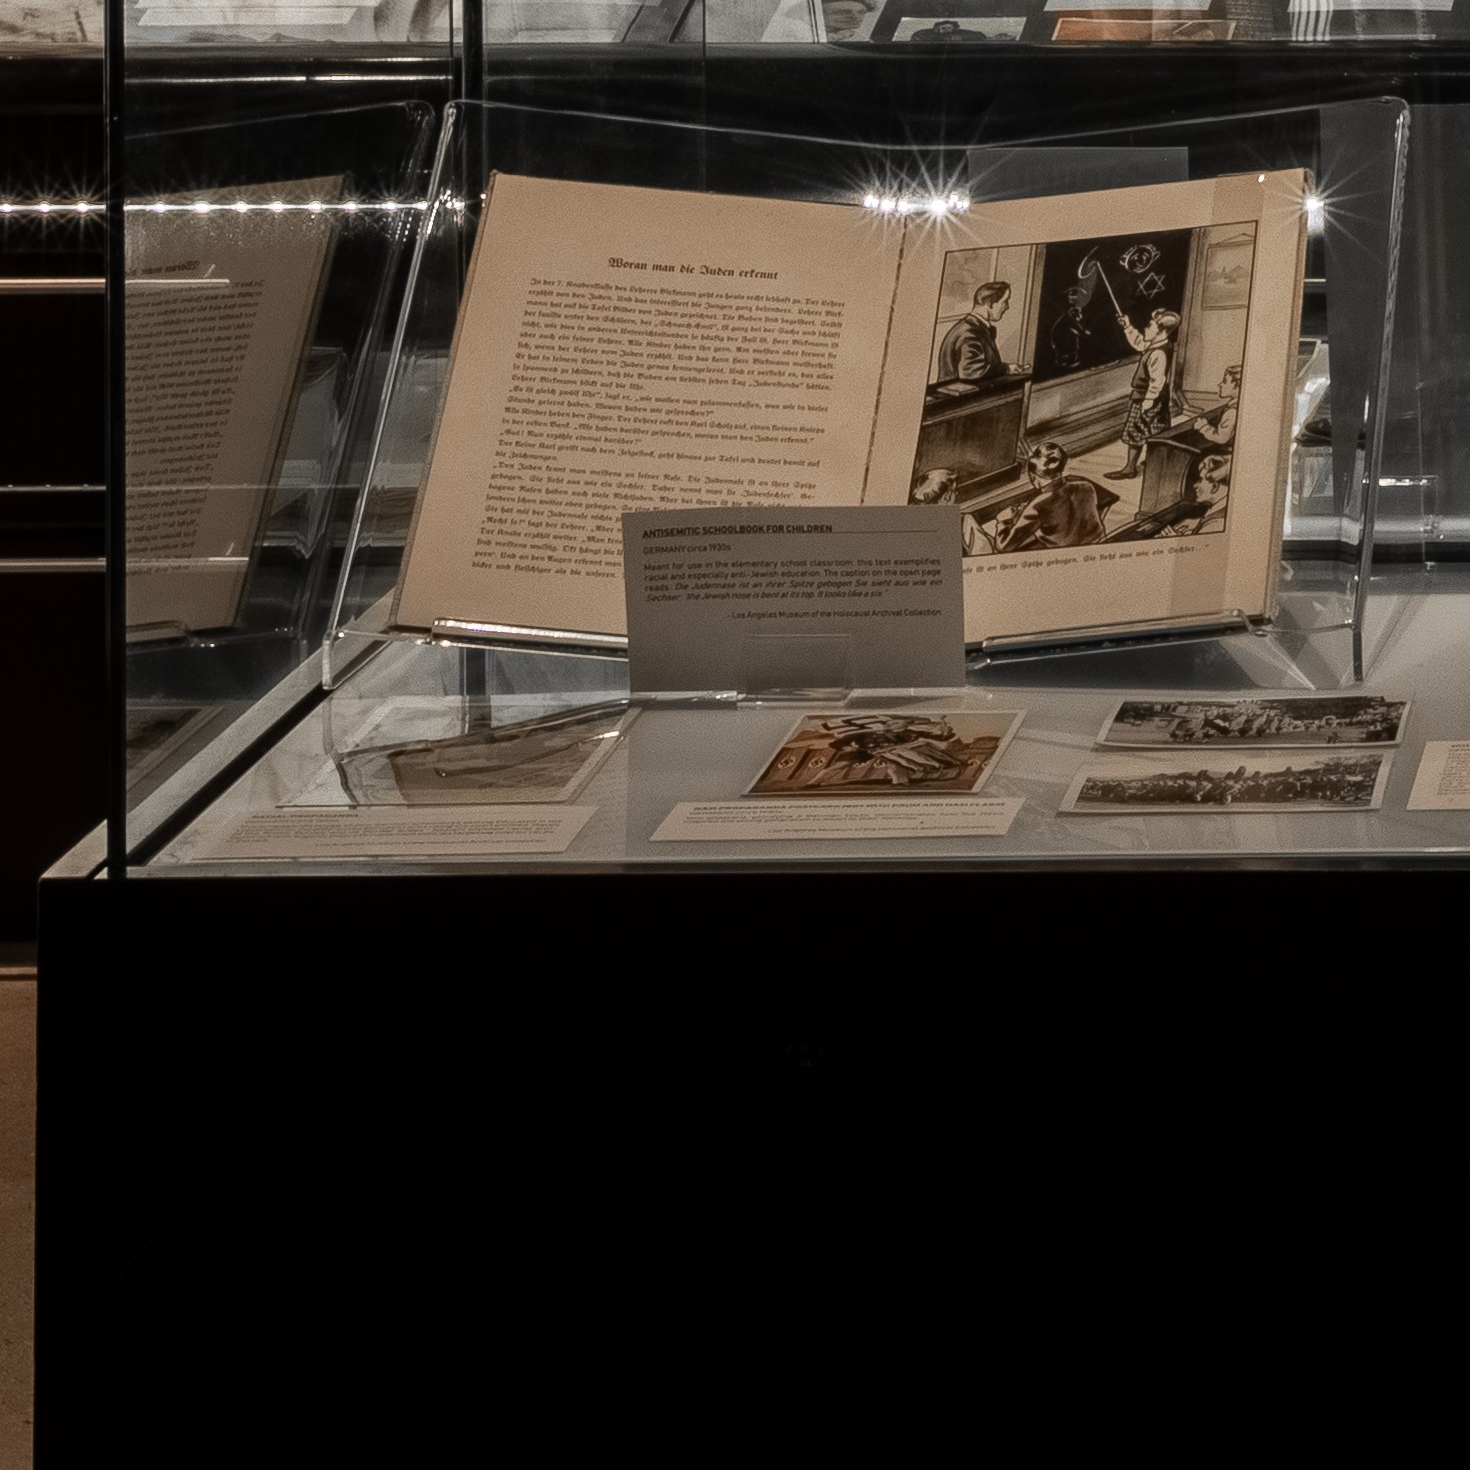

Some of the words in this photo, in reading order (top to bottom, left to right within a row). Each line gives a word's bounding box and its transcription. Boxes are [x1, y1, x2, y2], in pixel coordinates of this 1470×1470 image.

[608, 257, 647, 271] Woran
[652, 264, 675, 272] man
[680, 264, 694, 274] die
[700, 265, 734, 277] Juden
[739, 269, 778, 280] erkennt
[643, 527, 700, 539] ANTISEMITIC
[702, 525, 765, 535] SCHOOLBOOK
[766, 525, 784, 533] FOR
[786, 525, 832, 533] CHILDREN
[643, 545, 686, 555] GERMANY
[687, 544, 707, 552] circa
[709, 543, 731, 552] 1930s
[644, 563, 669, 571] Meant
[731, 560, 778, 569] elementary
[780, 559, 807, 567] school
[894, 557, 940, 566] exemplifies
[644, 573, 668, 581] racial
[670, 572, 685, 580] and
[687, 571, 728, 580] especially
[731, 570, 779, 578] anti-Jewish
[840, 569, 870, 578] caption
[900, 569, 919, 577] open
[921, 569, 941, 577] page
[789, 580, 814, 589] Spitze
[701, 592, 730, 600] Jewish
[747, 611, 777, 619] Angeles
[779, 610, 810, 618] Museum
[904, 608, 941, 616] Collection
